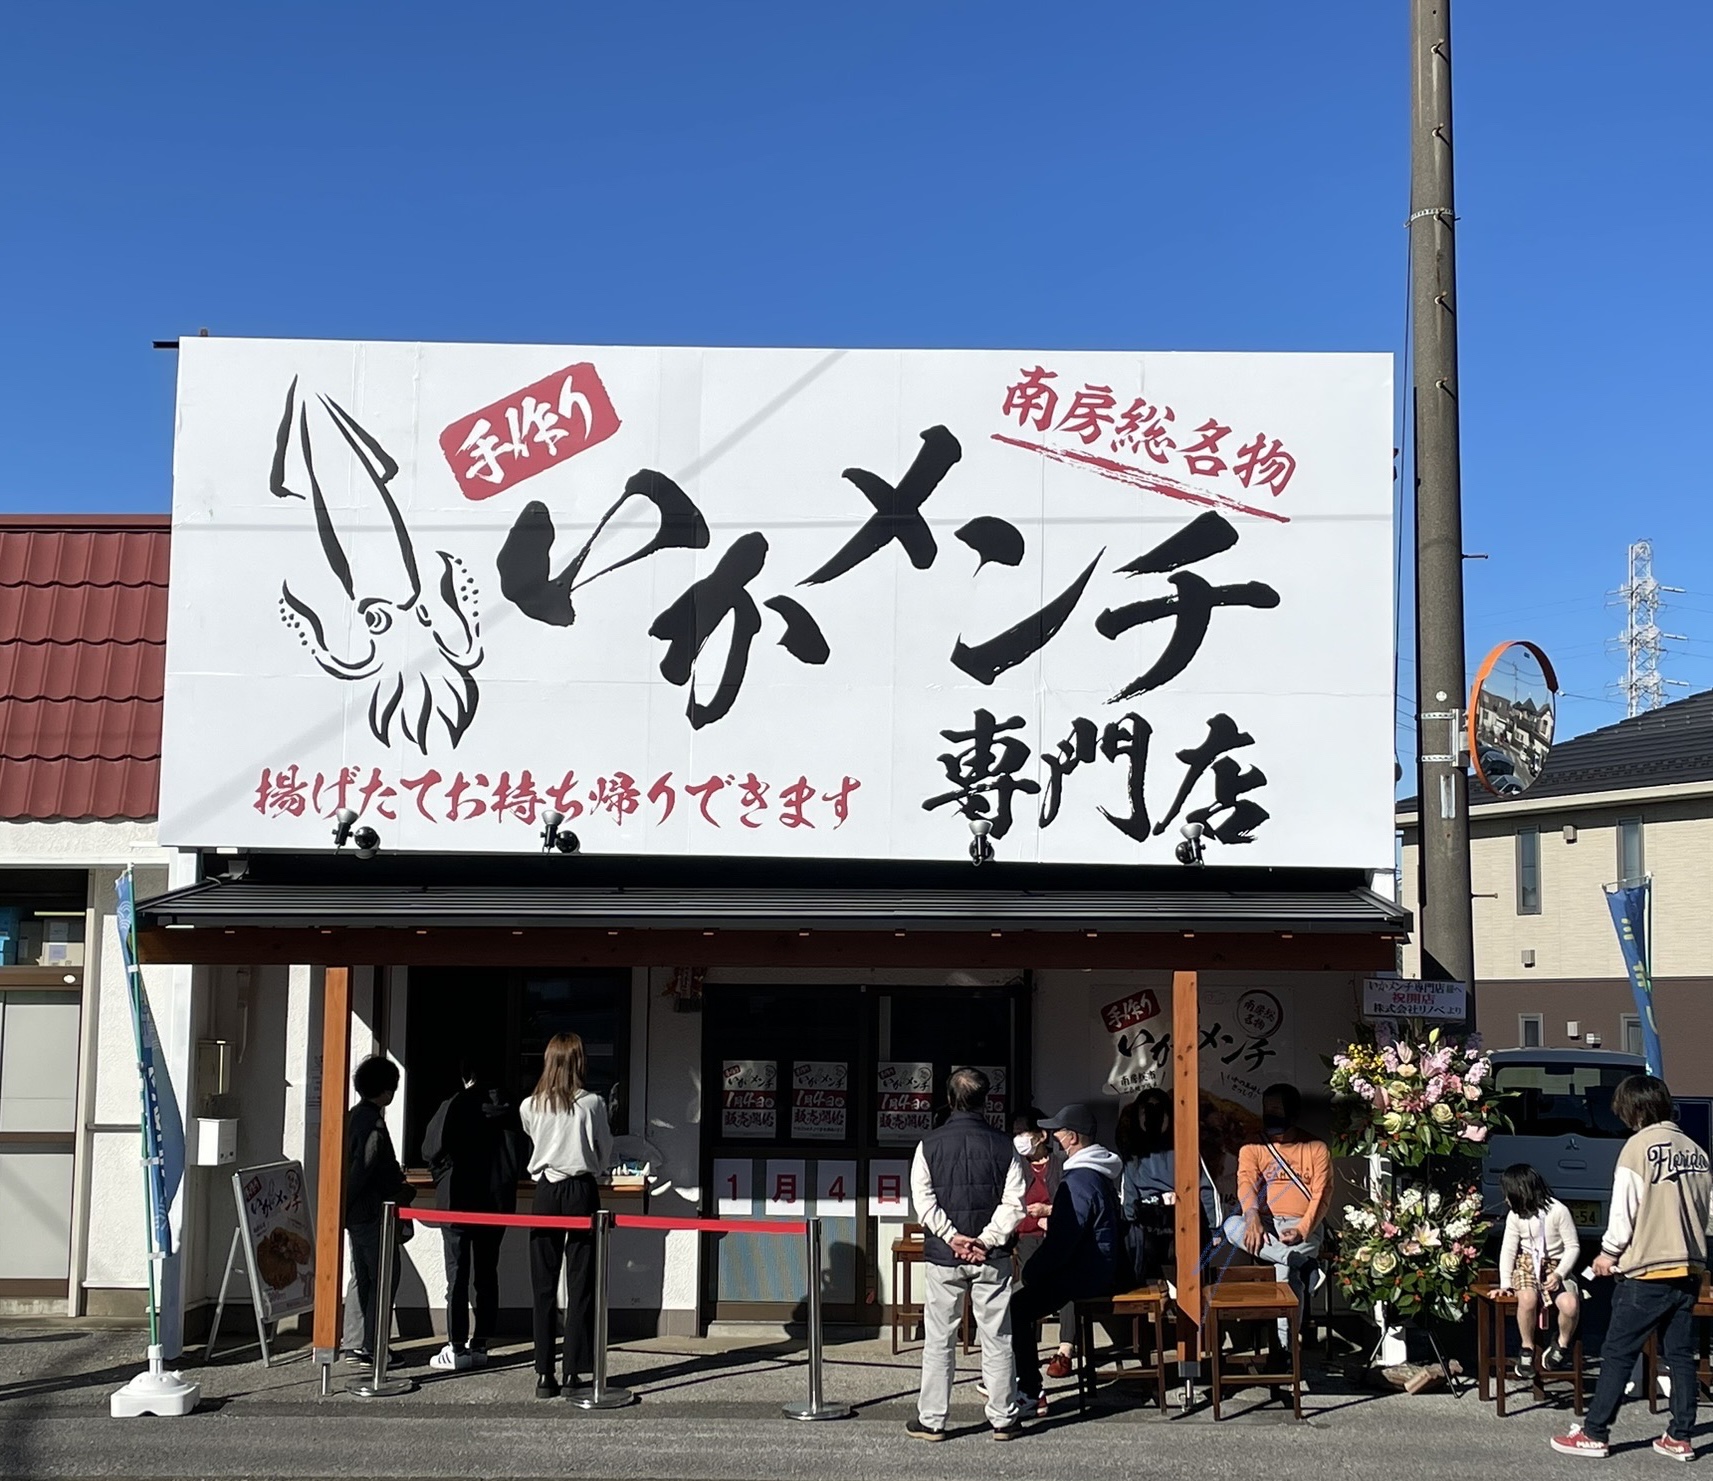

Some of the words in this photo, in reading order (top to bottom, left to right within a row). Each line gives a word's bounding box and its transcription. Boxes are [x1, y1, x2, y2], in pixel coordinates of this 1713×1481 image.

[455, 373, 595, 484] 手作り
[1001, 365, 1297, 497] 南房総名物
[497, 425, 1281, 730] いかメンチ
[253, 764, 862, 831] 揚げたてお持ち帰りできます
[921, 708, 1271, 846] 専門店
[1106, 993, 1154, 1029] 手作り
[1392, 992, 1436, 1005] 祝開店
[1266, 1171, 1310, 1180] CAMNG
[1647, 1142, 1710, 1184] Florida
